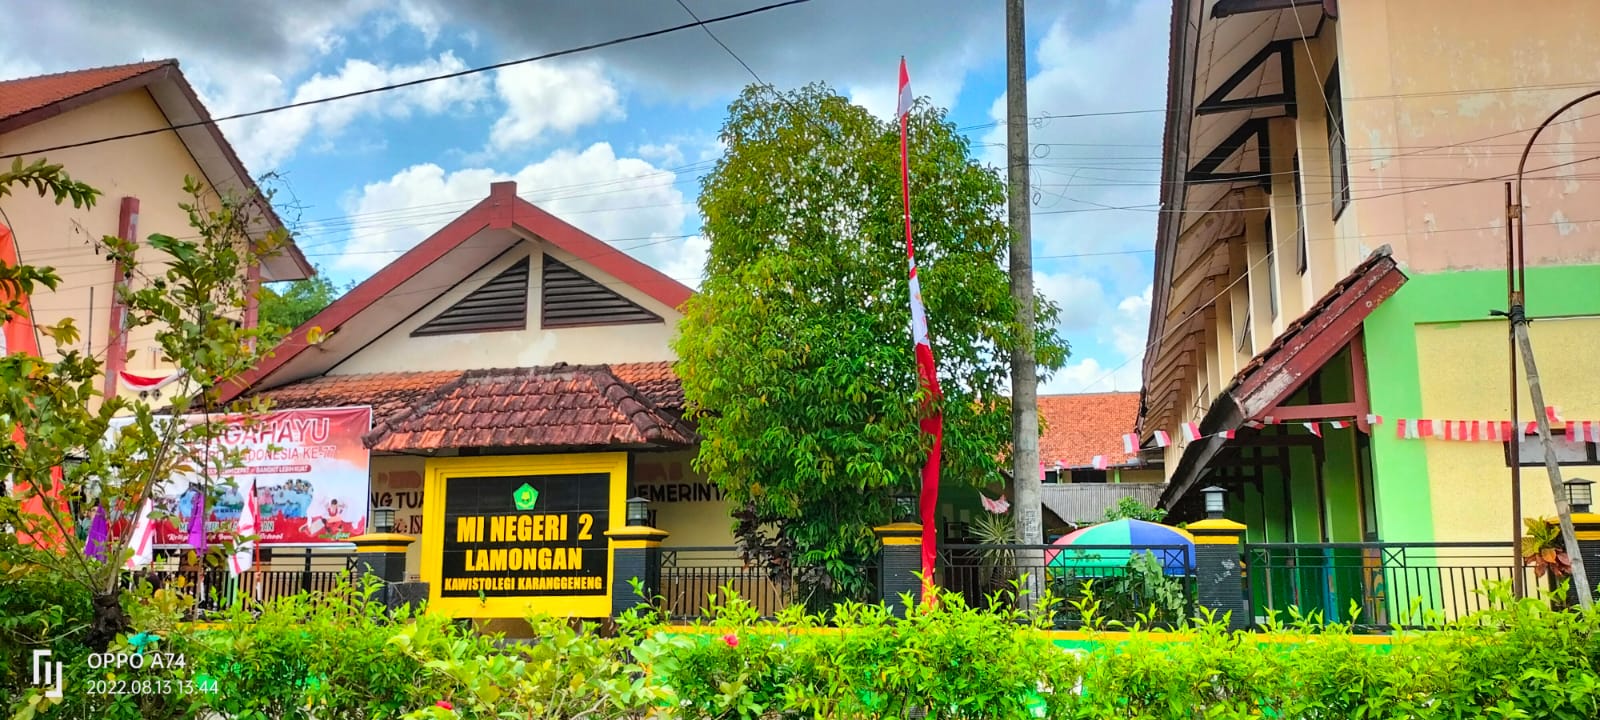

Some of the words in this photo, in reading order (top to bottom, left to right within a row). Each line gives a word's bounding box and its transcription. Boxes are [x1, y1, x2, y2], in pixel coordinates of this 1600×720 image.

[457, 516, 485, 543] MI
[490, 514, 568, 542] NEGERI
[578, 513, 594, 540] 2
[465, 547, 583, 572] LAMONGAN
[444, 577, 515, 591] KAWISTOLEGI
[518, 576, 603, 590] KARANGGENENG
